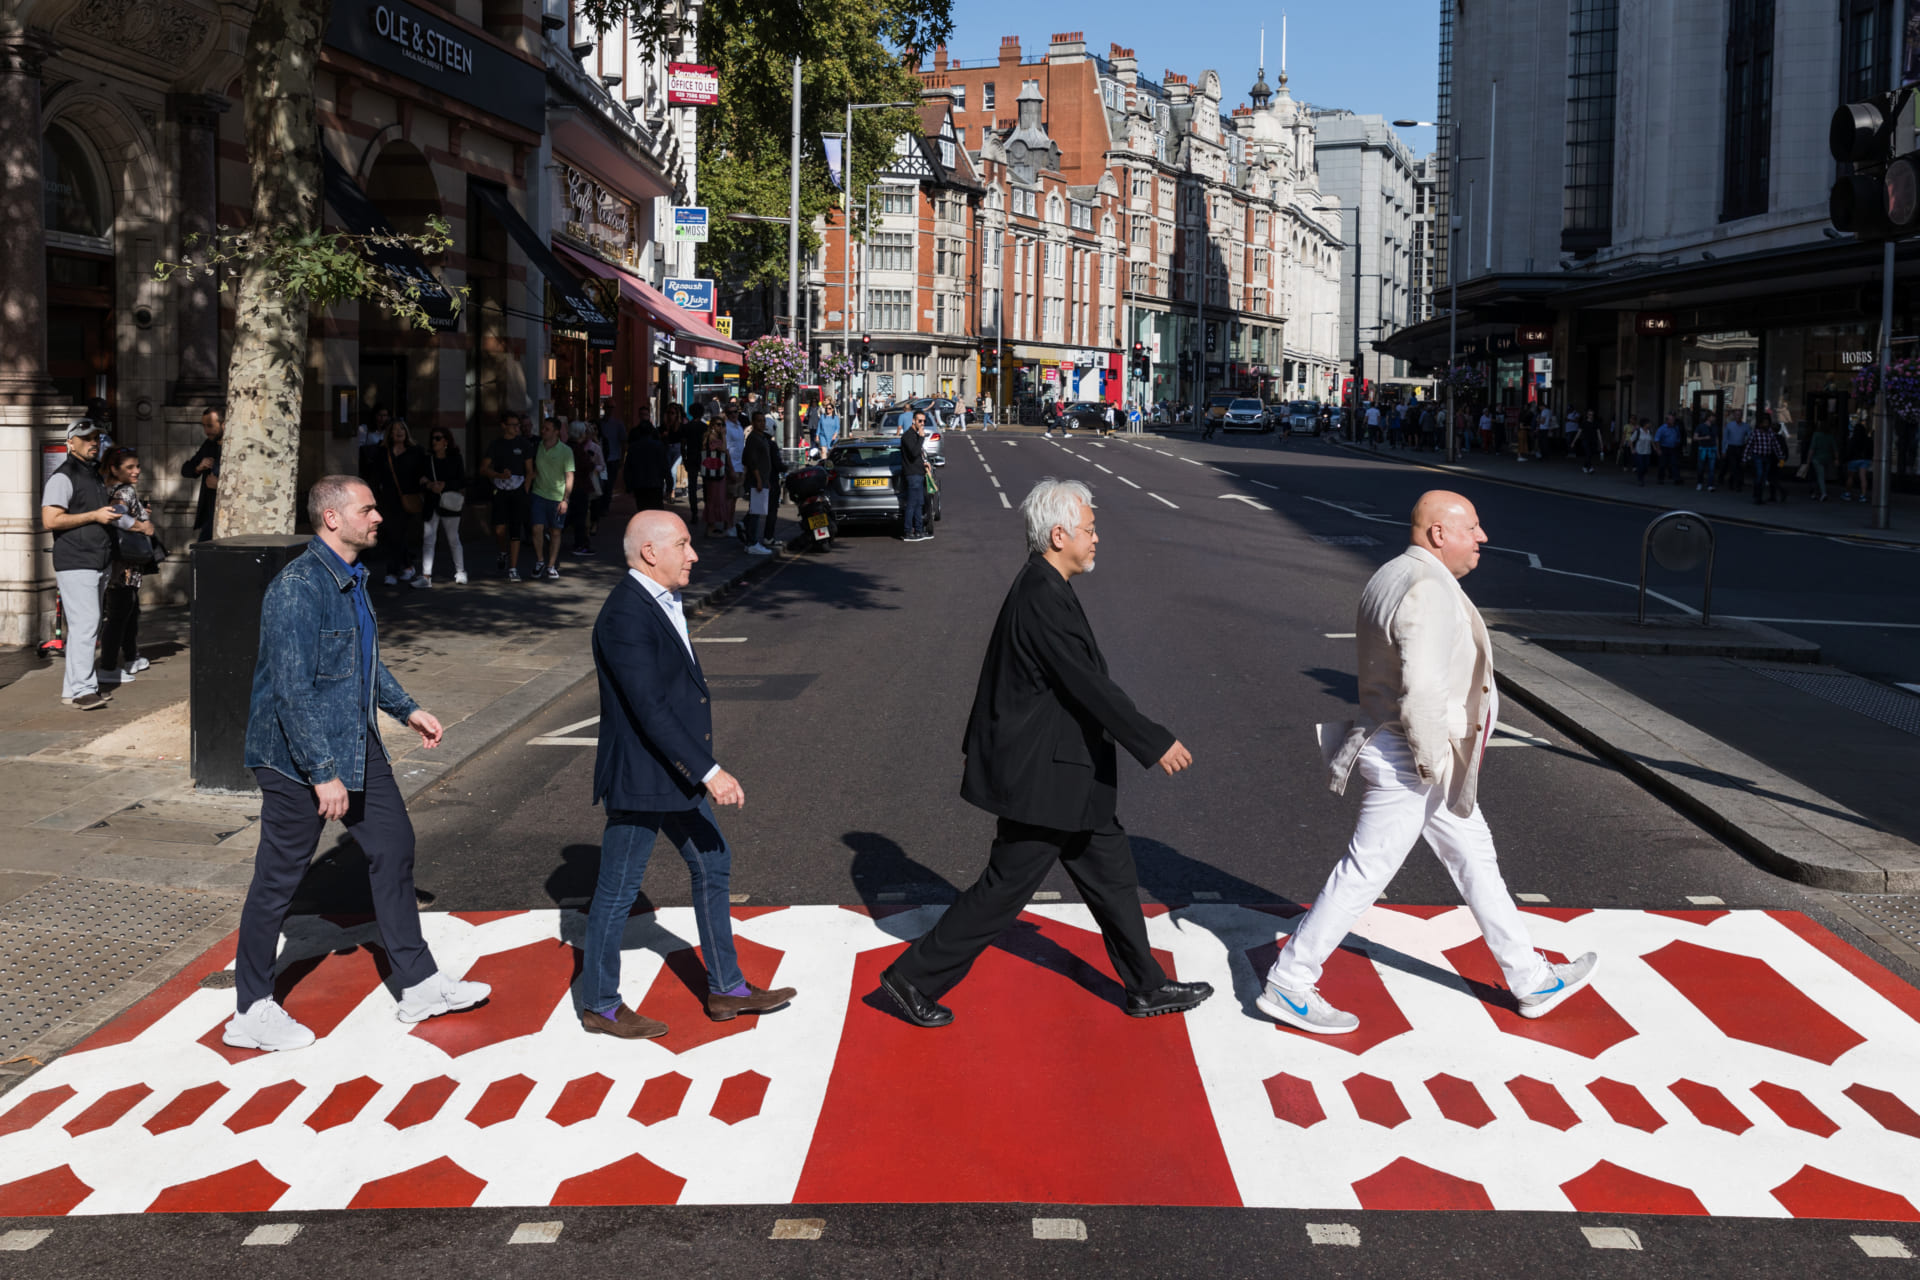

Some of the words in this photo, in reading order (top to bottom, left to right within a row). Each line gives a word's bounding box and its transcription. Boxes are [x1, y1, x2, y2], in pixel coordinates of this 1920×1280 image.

[376, 5, 409, 46] OLE
[412, 22, 424, 53] &
[426, 29, 472, 74] STEEN
[671, 79, 693, 90] OFFICE
[695, 82, 704, 91] TO
[705, 83, 715, 92] LET
[685, 225, 706, 236] MOSS
[668, 281, 703, 291] Ranoush
[688, 295, 709, 306] Juice
[1640, 319, 1671, 329] HEMA
[1842, 351, 1873, 364] HOBBS
